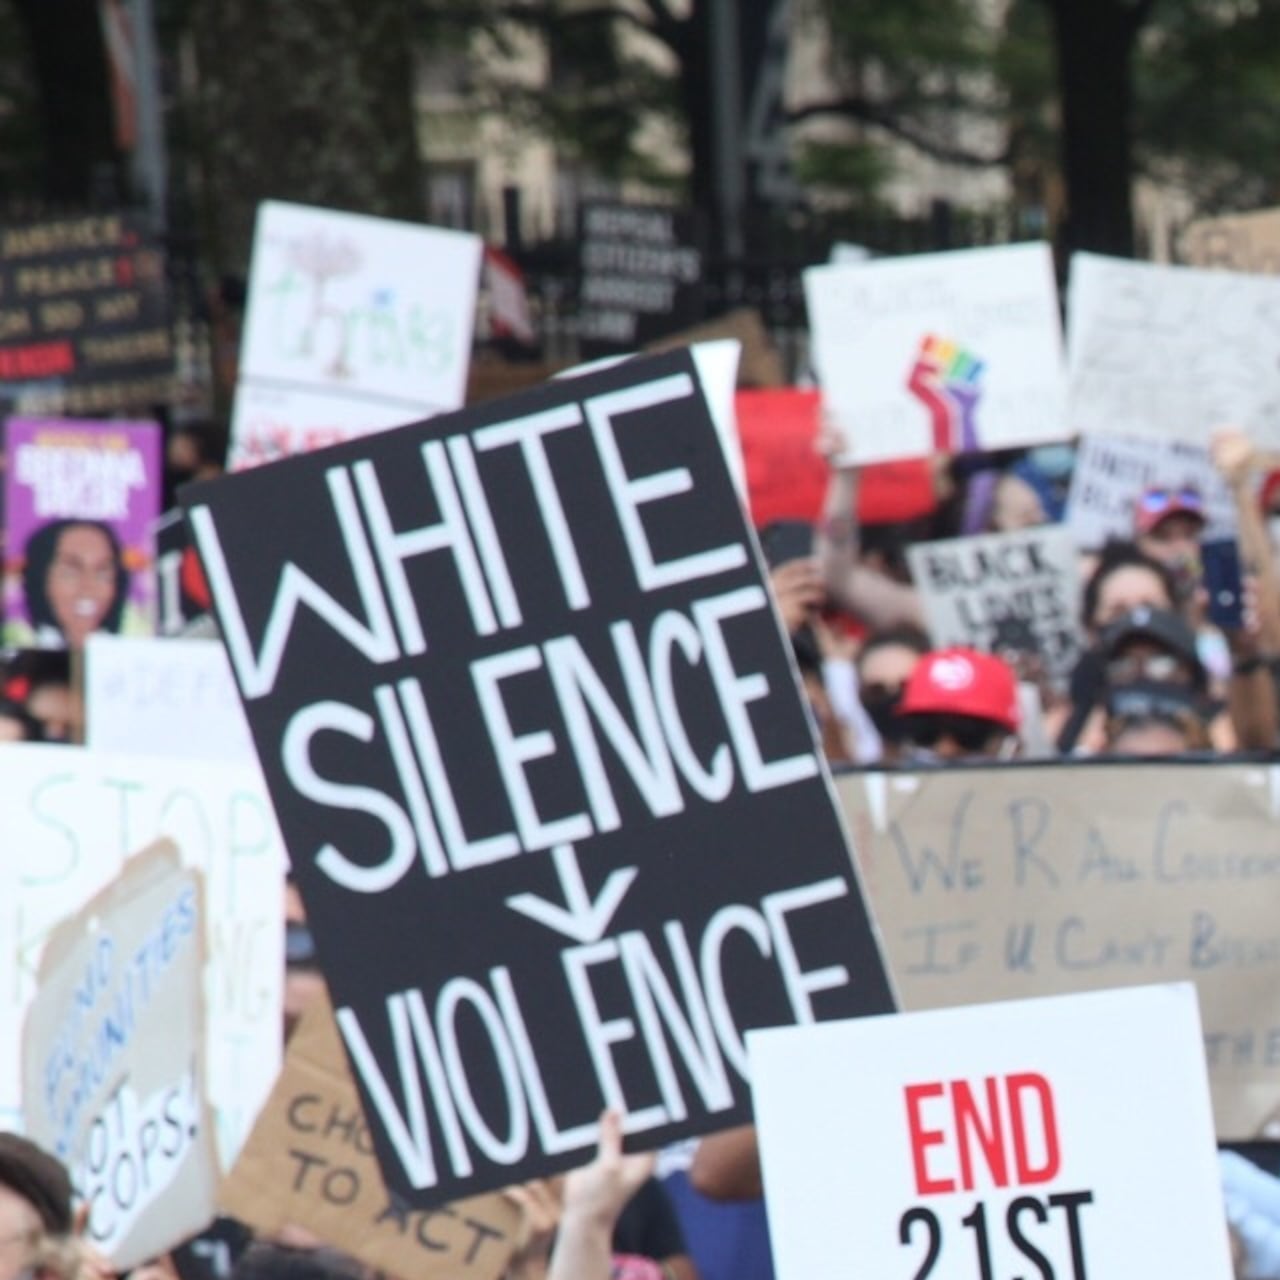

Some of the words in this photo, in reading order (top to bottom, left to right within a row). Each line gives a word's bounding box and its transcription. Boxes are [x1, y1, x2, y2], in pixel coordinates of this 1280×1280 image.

[189, 372, 749, 700] WHITE
[280, 585, 820, 894] SILENCE
[1003, 795, 1061, 889] R
[336, 876, 851, 1189] VIOLENCE
[904, 1071, 1062, 1197] END
[287, 1149, 360, 1206] TO
